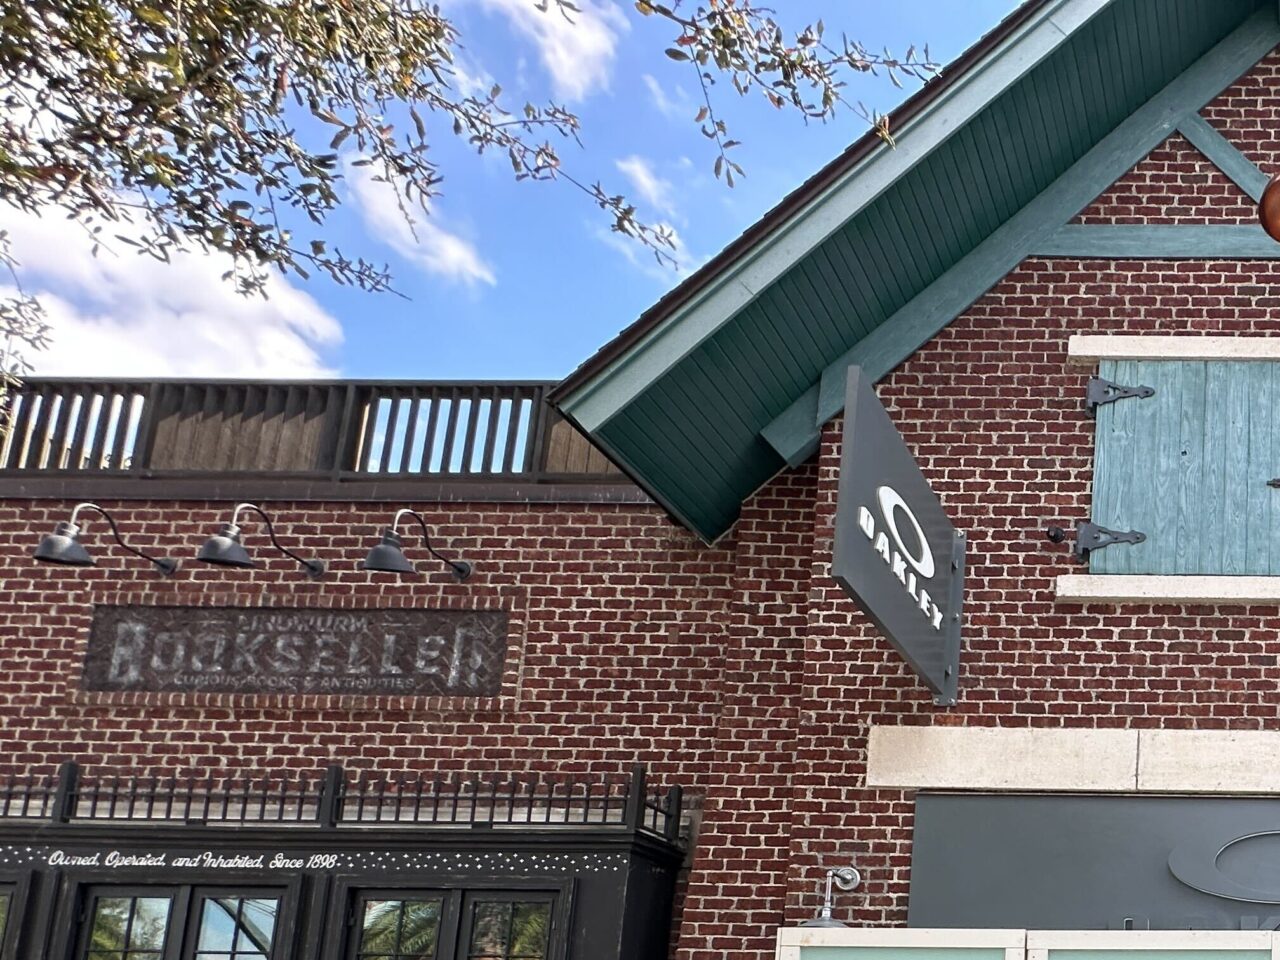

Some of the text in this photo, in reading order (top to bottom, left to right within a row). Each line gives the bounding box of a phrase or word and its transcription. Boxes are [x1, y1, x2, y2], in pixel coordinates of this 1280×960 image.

[857, 506, 943, 630] OAKLEY
[109, 621, 486, 688] BOOKSELLER
[171, 854, 201, 867] and
[269, 853, 304, 868] Since
